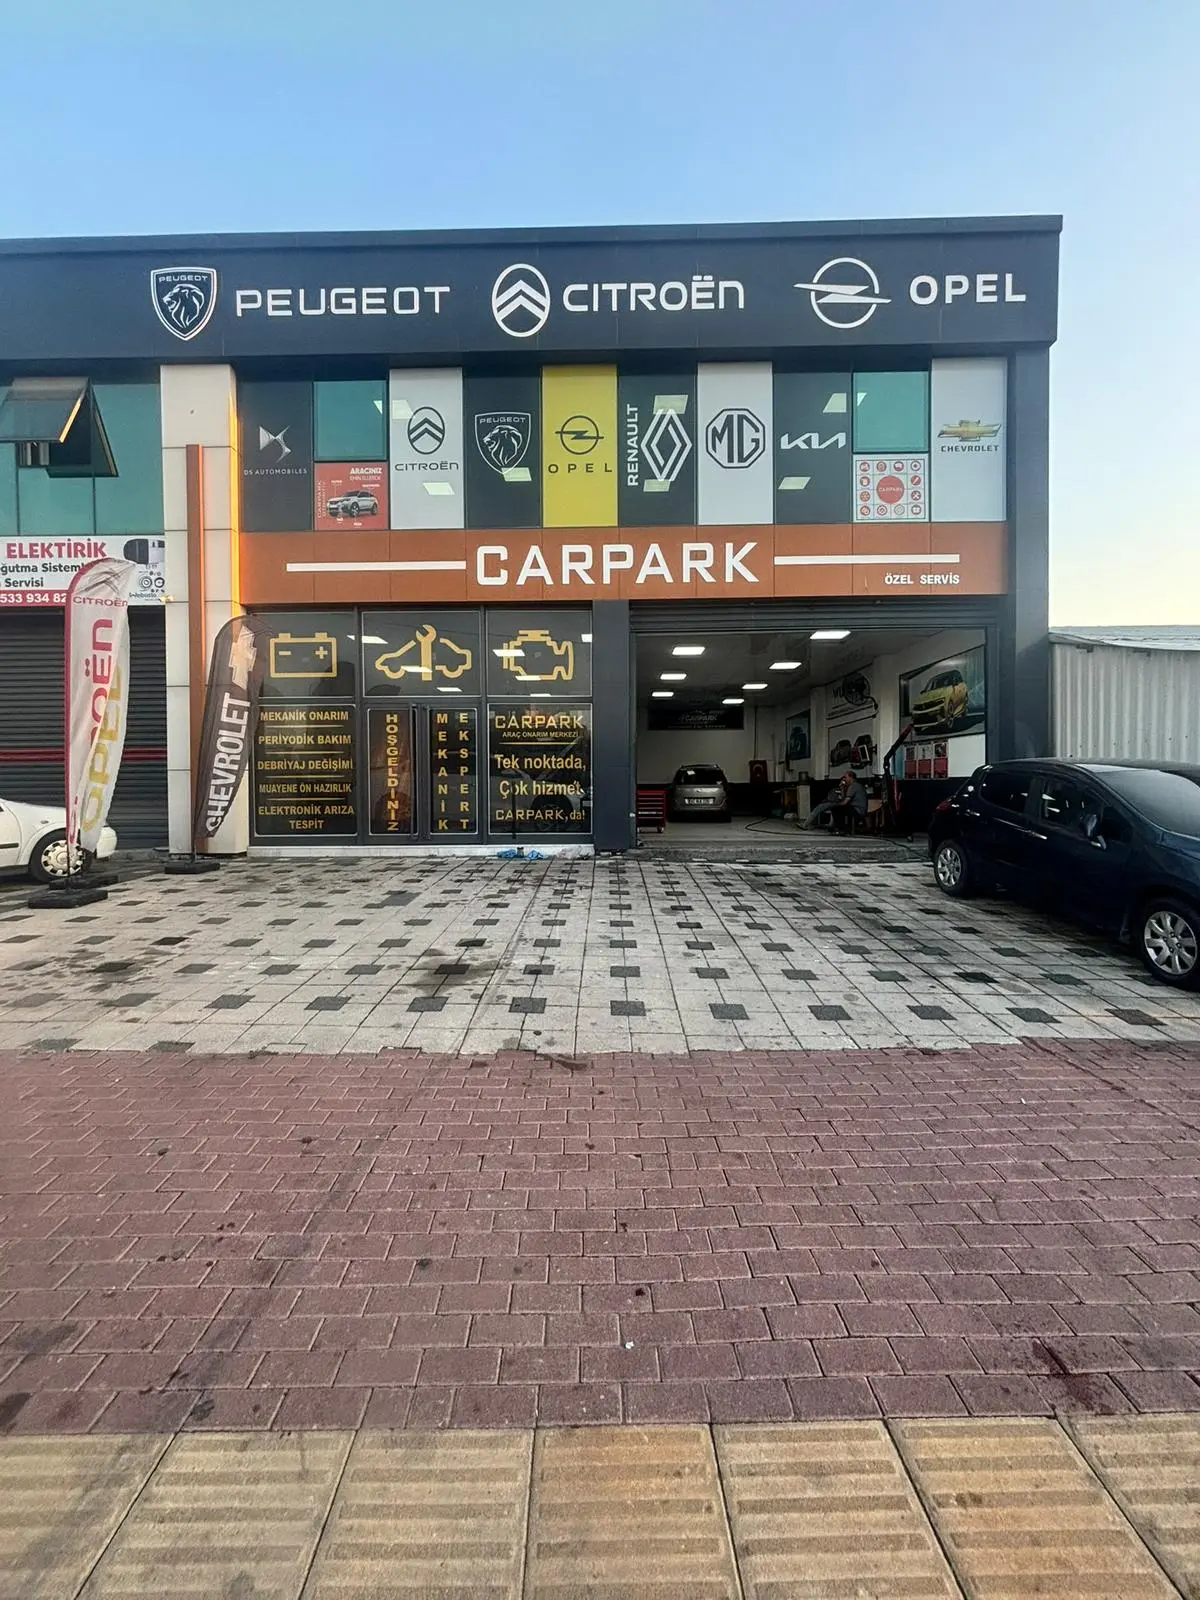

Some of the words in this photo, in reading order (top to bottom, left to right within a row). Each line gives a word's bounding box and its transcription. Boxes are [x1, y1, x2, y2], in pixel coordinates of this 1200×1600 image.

[158, 274, 208, 283] PEUGEOT
[562, 274, 745, 313] CITROËN
[909, 272, 1028, 305] OPEL
[235, 284, 451, 318] PEUGEOT
[479, 416, 526, 424] PEUGEOT
[626, 403, 640, 486] RENAULT
[710, 414, 760, 464] MG
[780, 431, 847, 450] KIA
[940, 444, 1000, 453] CHEVROLET
[394, 460, 459, 472] CITROËN
[547, 463, 613, 474] OPEL
[6, 538, 108, 559] ELEKTİRİK
[476, 541, 760, 586] CARPARK
[4, 577, 44, 588] Servisi
[884, 572, 914, 585] ÖZEL
[919, 572, 960, 585] SERVİS
[26, 593, 50, 603] 934
[73, 597, 128, 607] CITROËN
[260, 709, 306, 721] MEKANİK
[308, 710, 349, 721] ONARIM
[494, 715, 584, 729] CARPARK
[258, 733, 315, 745] PERİYODİK
[317, 735, 352, 745] BAKIM
[549, 730, 579, 738] MERKEZİ
[81, 666, 122, 833] OPEL
[205, 692, 252, 832] CHEVROLET
[257, 759, 306, 770] DEBRİYAJ
[308, 758, 353, 772] DEĞİŞİMİ
[494, 754, 520, 769] Tek
[524, 754, 586, 772] noktada,
[436, 713, 449, 831] MEKANİK
[458, 712, 470, 829] EKSPERT
[258, 783, 298, 793] MUAYENE
[313, 783, 352, 793] HAZIRLIK
[258, 804, 322, 815] ELEKTRONİK
[324, 806, 355, 815] ARIZA
[289, 818, 325, 829] TESPİT
